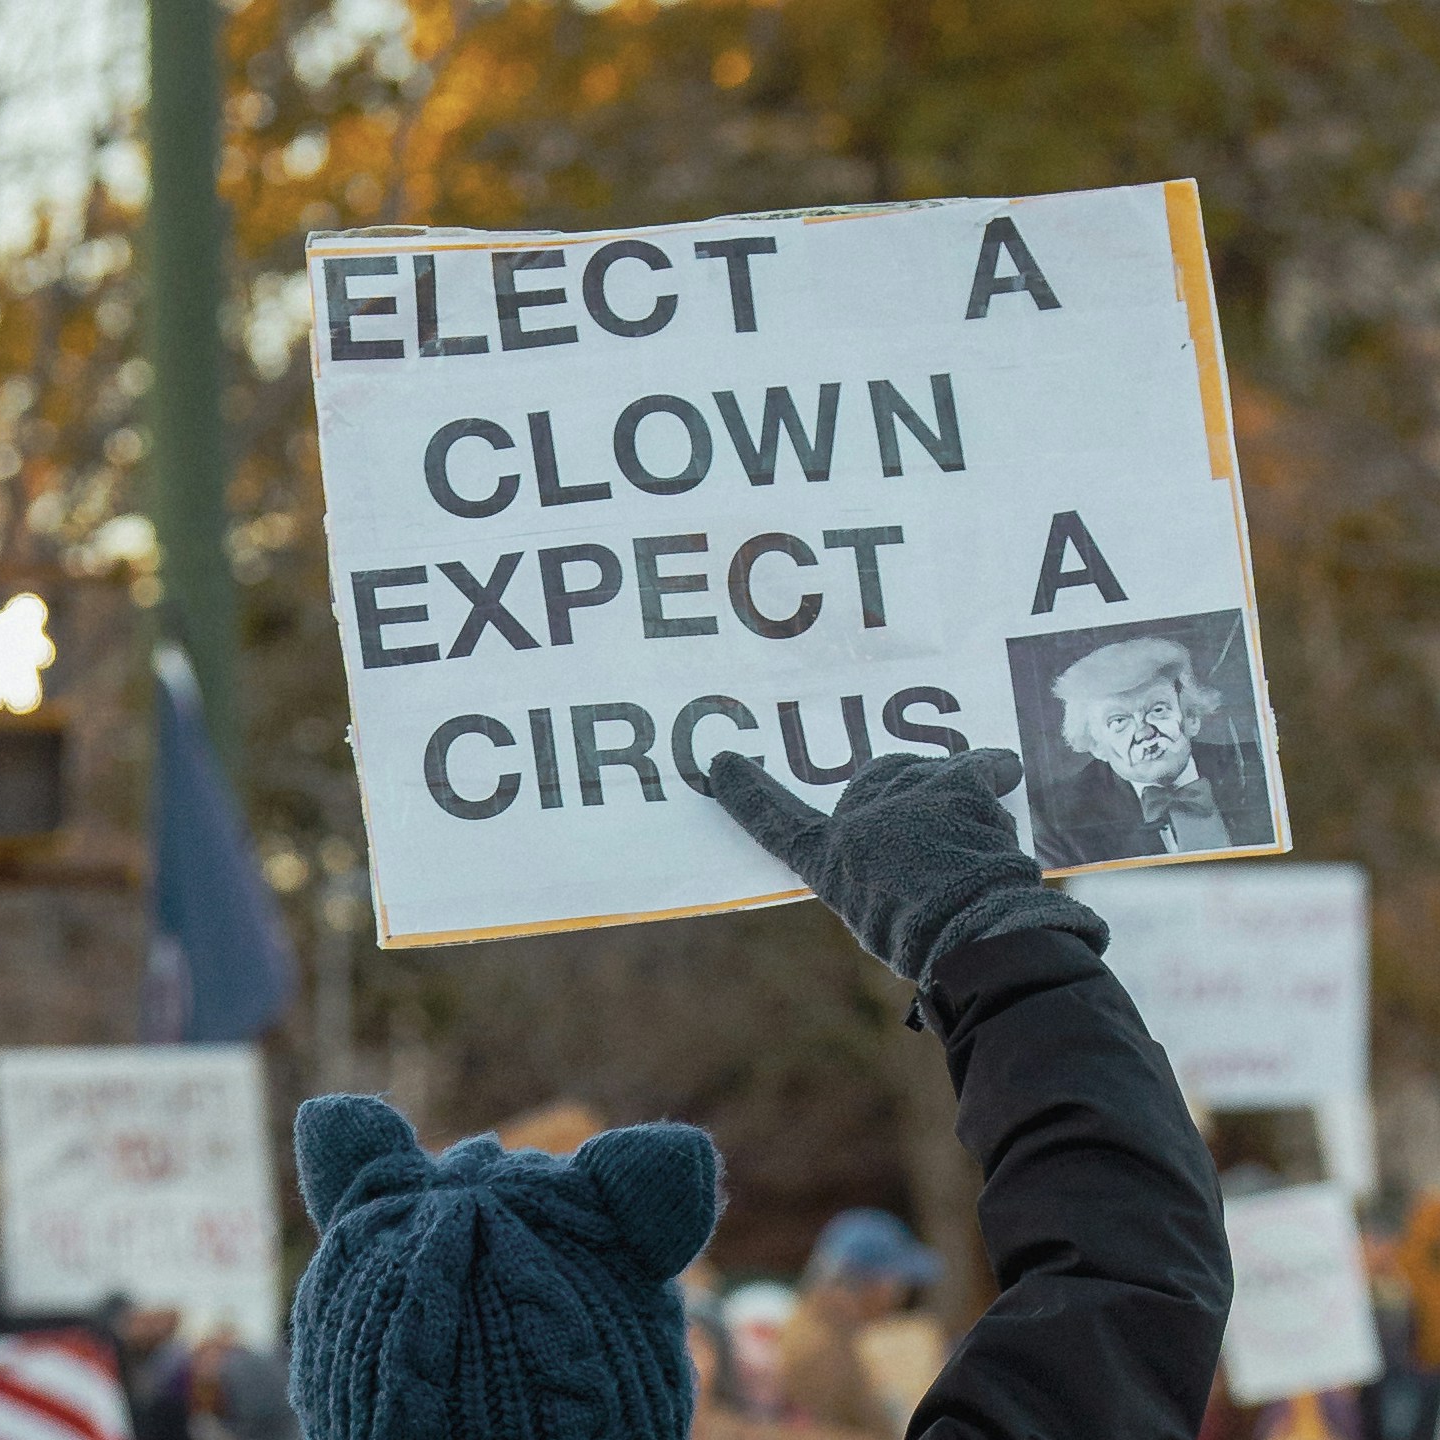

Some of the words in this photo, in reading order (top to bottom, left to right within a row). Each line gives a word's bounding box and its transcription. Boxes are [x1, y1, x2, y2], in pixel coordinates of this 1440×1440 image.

[324, 237, 777, 361] ELECT
[964, 216, 1062, 319] A
[424, 373, 966, 519] CLOWN
[350, 525, 904, 669] EXPECT
[1030, 510, 1128, 615] A
[423, 686, 970, 820] CIRCUS
